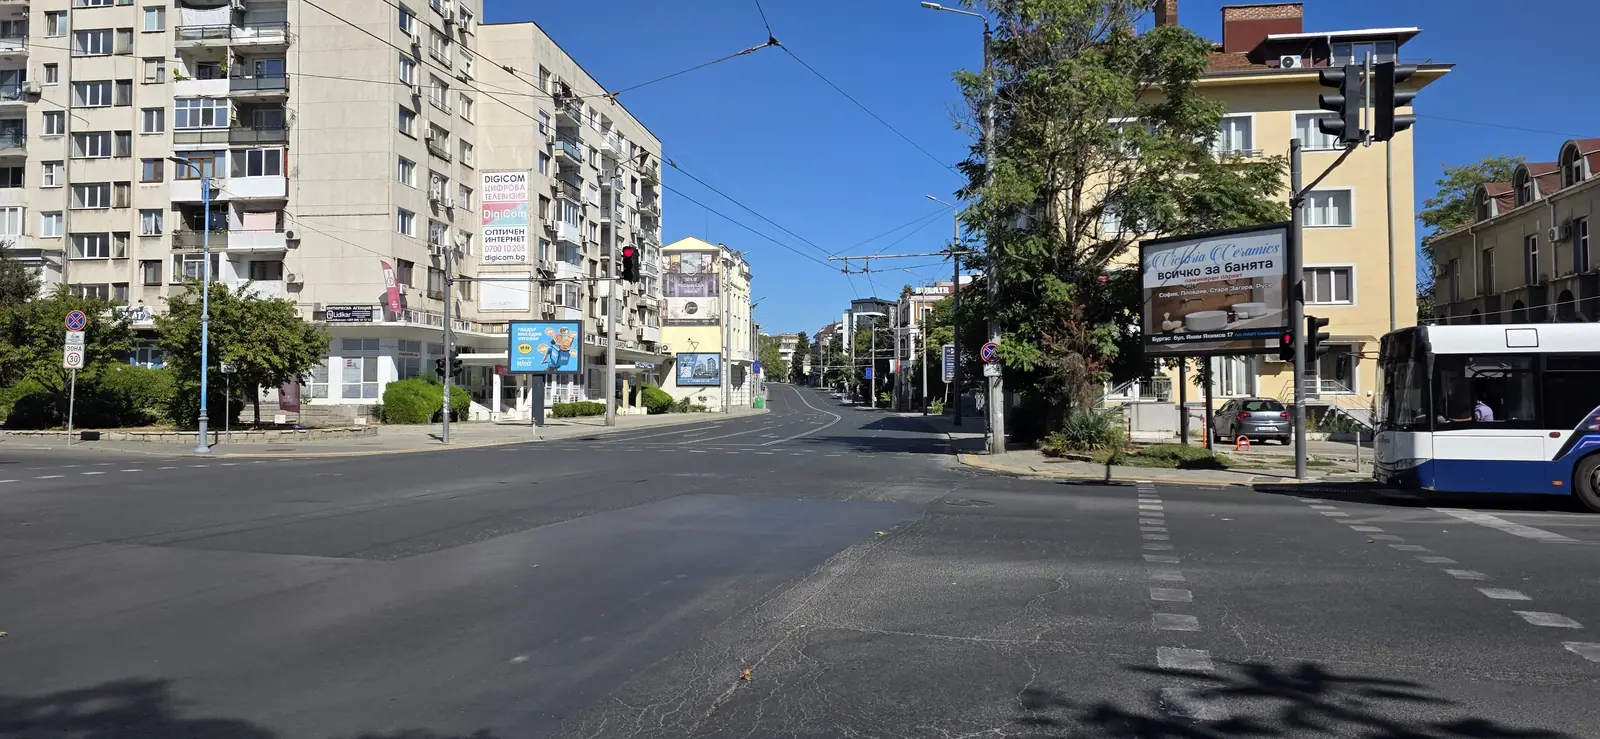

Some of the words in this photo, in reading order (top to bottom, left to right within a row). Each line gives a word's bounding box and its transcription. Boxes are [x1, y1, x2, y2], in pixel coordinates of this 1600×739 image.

[484, 174, 526, 183] DIGICOM
[484, 184, 526, 192] ЦИФРОВА
[483, 209, 527, 220] DigiCom
[1152, 248, 1206, 269] Victoria
[1210, 242, 1280, 264] Ceramics
[1158, 268, 1200, 280] всичко
[1205, 266, 1220, 275] за
[1225, 260, 1273, 273] банята
